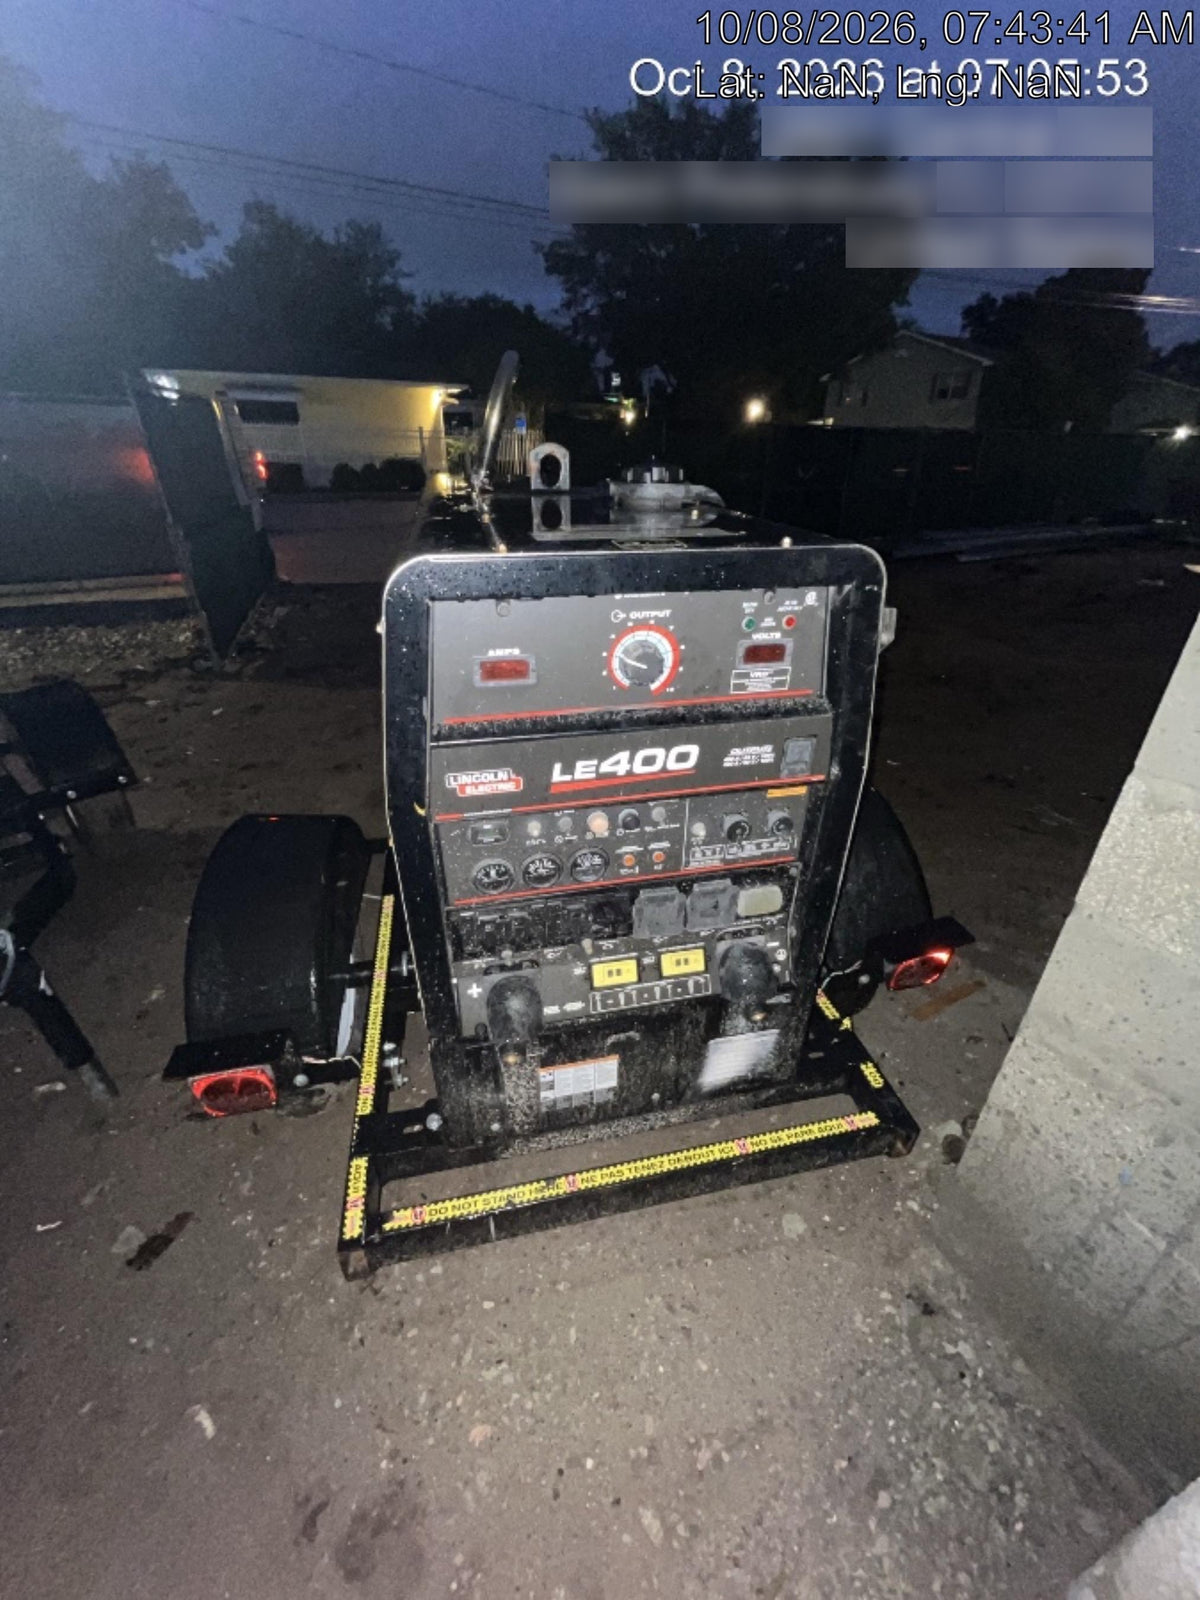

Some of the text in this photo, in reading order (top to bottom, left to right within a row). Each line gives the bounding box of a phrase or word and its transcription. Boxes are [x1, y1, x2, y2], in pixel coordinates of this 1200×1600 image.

[629, 609, 672, 619] OUTPUT
[752, 632, 782, 640] VOLTS
[486, 647, 520, 657] AMPS
[551, 744, 700, 783] LE400
[449, 770, 509, 786] LINCOLN
[465, 781, 517, 795] ELECTRIC
[580, 1175, 598, 1185] NE
[600, 1170, 625, 1181] PAS
[627, 1159, 665, 1175] TENEZ
[428, 1206, 449, 1217] DO
[451, 1200, 479, 1213] NOT
[483, 1190, 527, 1206] STAND
